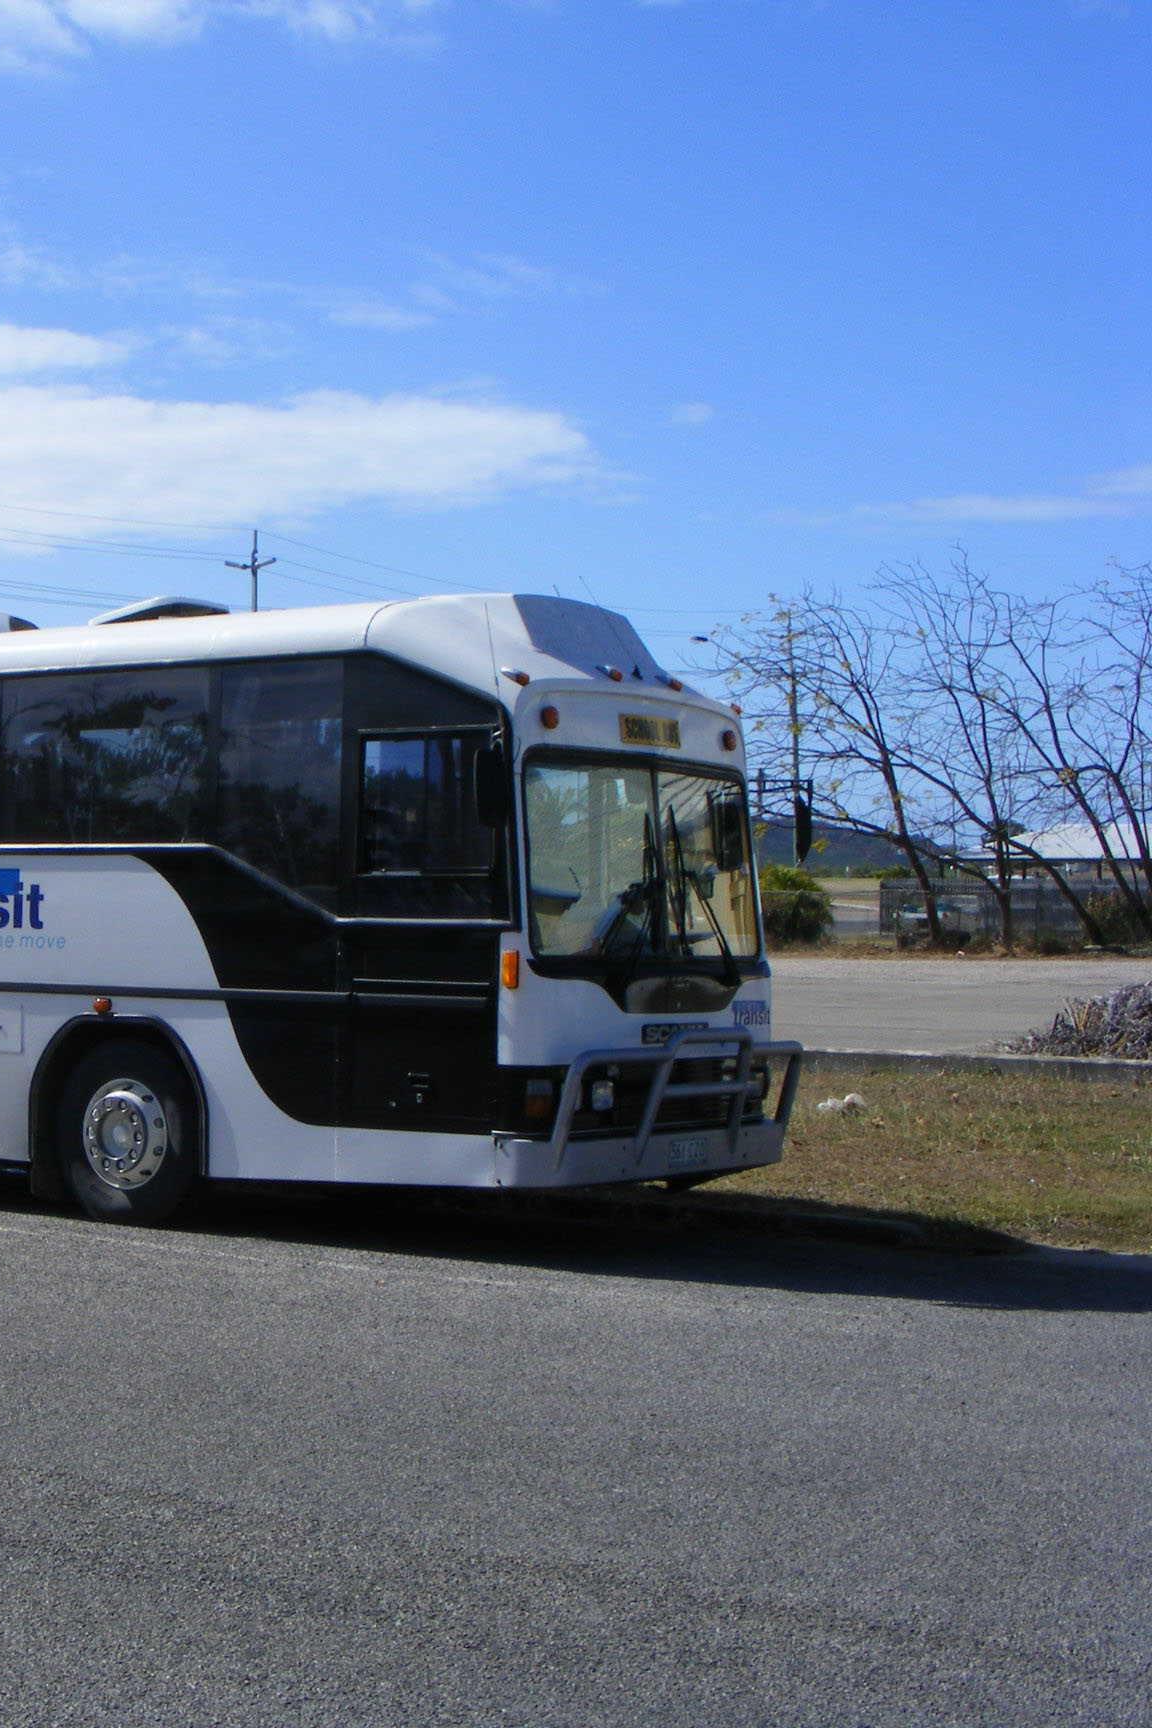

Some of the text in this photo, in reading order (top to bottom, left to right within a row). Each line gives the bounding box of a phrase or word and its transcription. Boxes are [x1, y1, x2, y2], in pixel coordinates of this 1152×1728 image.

[624, 717, 680, 746] SCHOOL BUS
[20, 934, 66, 950] move
